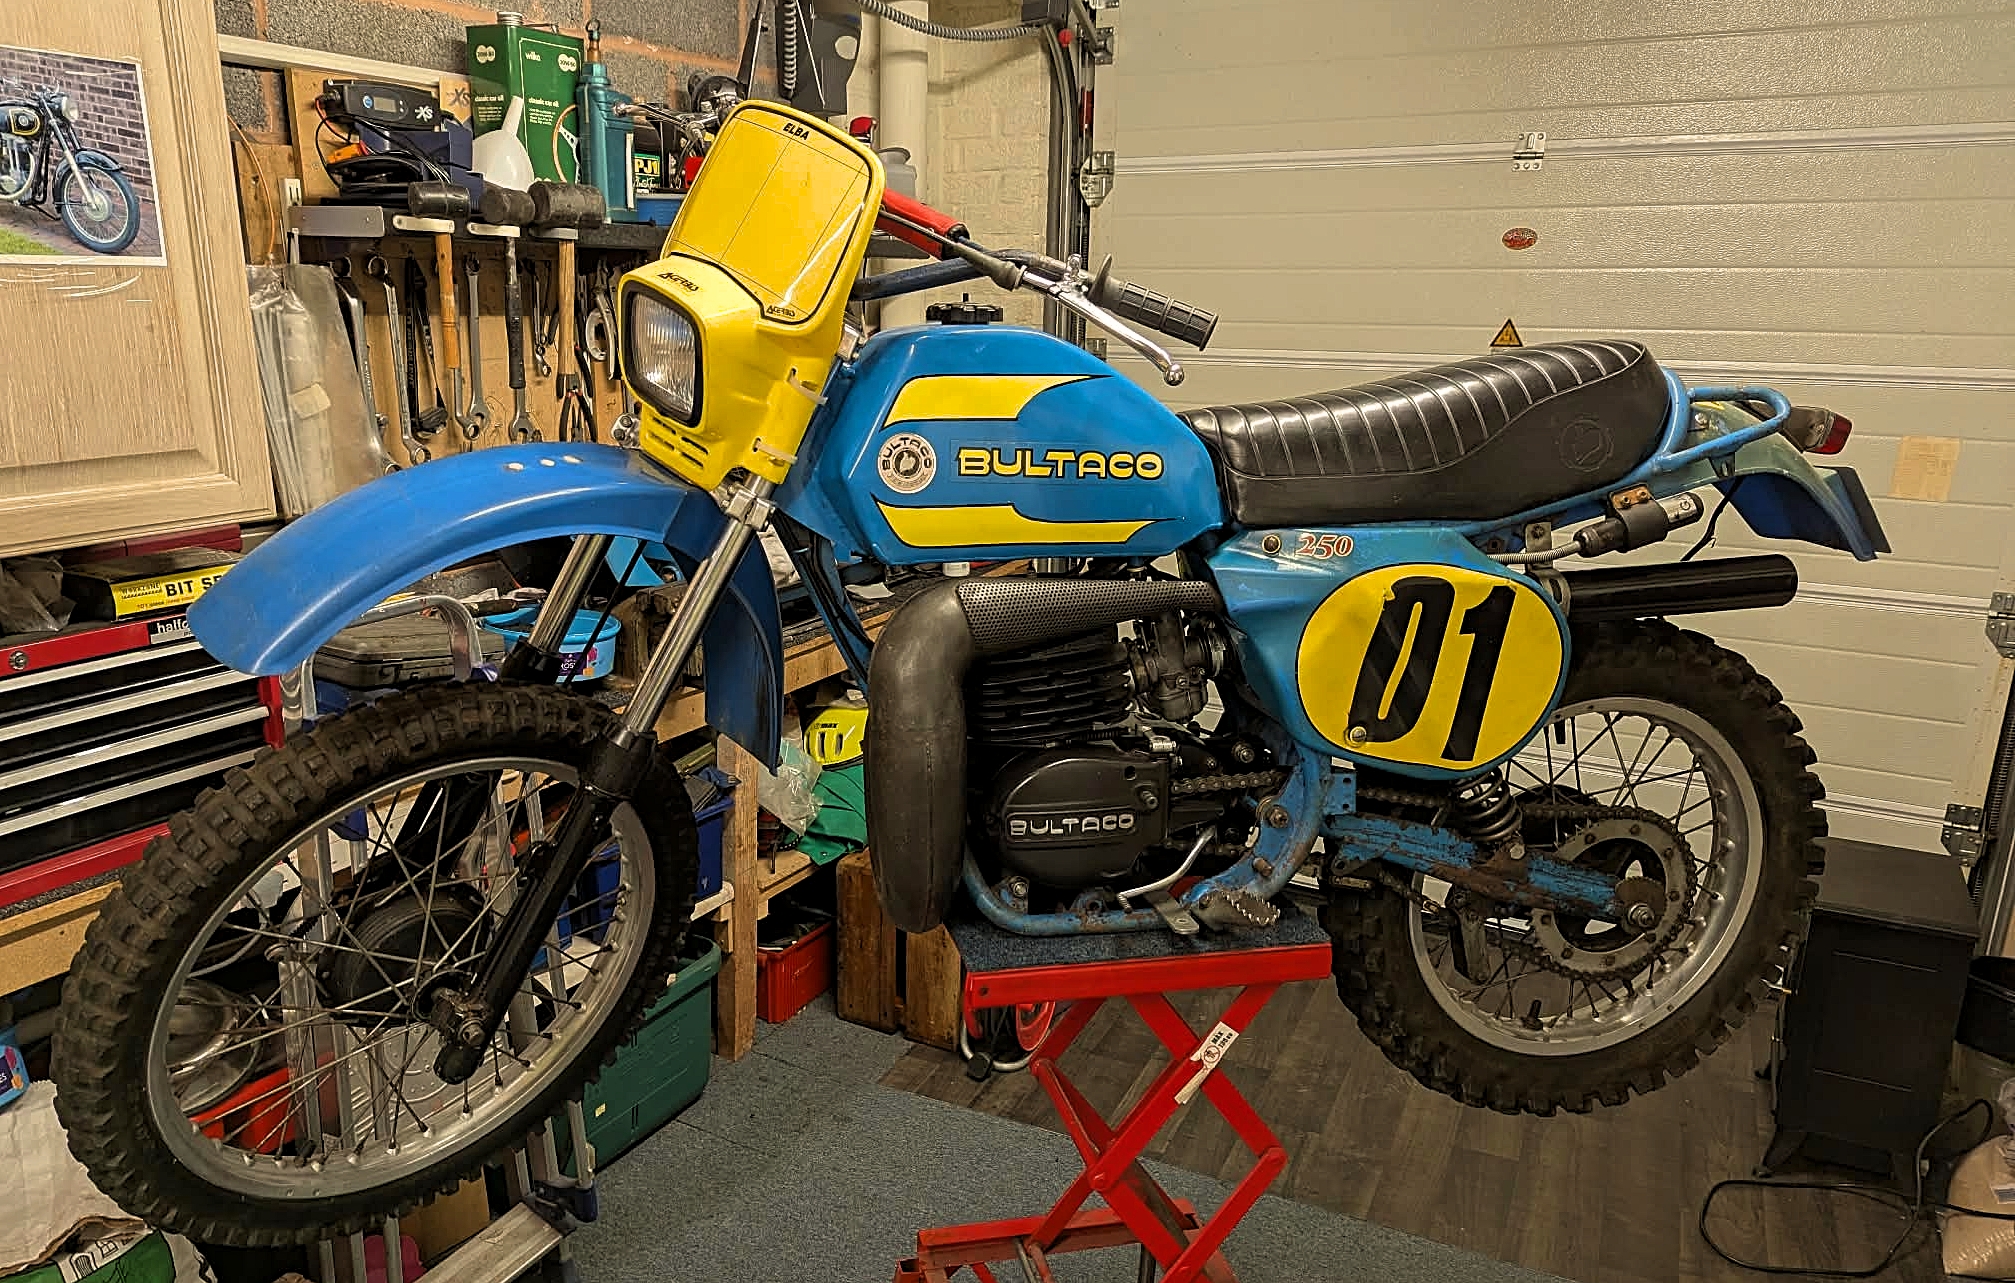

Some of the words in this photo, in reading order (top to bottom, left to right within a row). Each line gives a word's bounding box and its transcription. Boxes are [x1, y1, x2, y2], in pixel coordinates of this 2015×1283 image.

[525, 51, 541, 62] wilko
[783, 122, 810, 140] ELBA
[882, 437, 932, 470] BULTACO
[957, 447, 1164, 480] BULTACO
[1295, 532, 1354, 560] 250
[165, 580, 194, 597] BIT
[1347, 575, 1517, 762] 01
[1010, 813, 1134, 836] BULTACO
